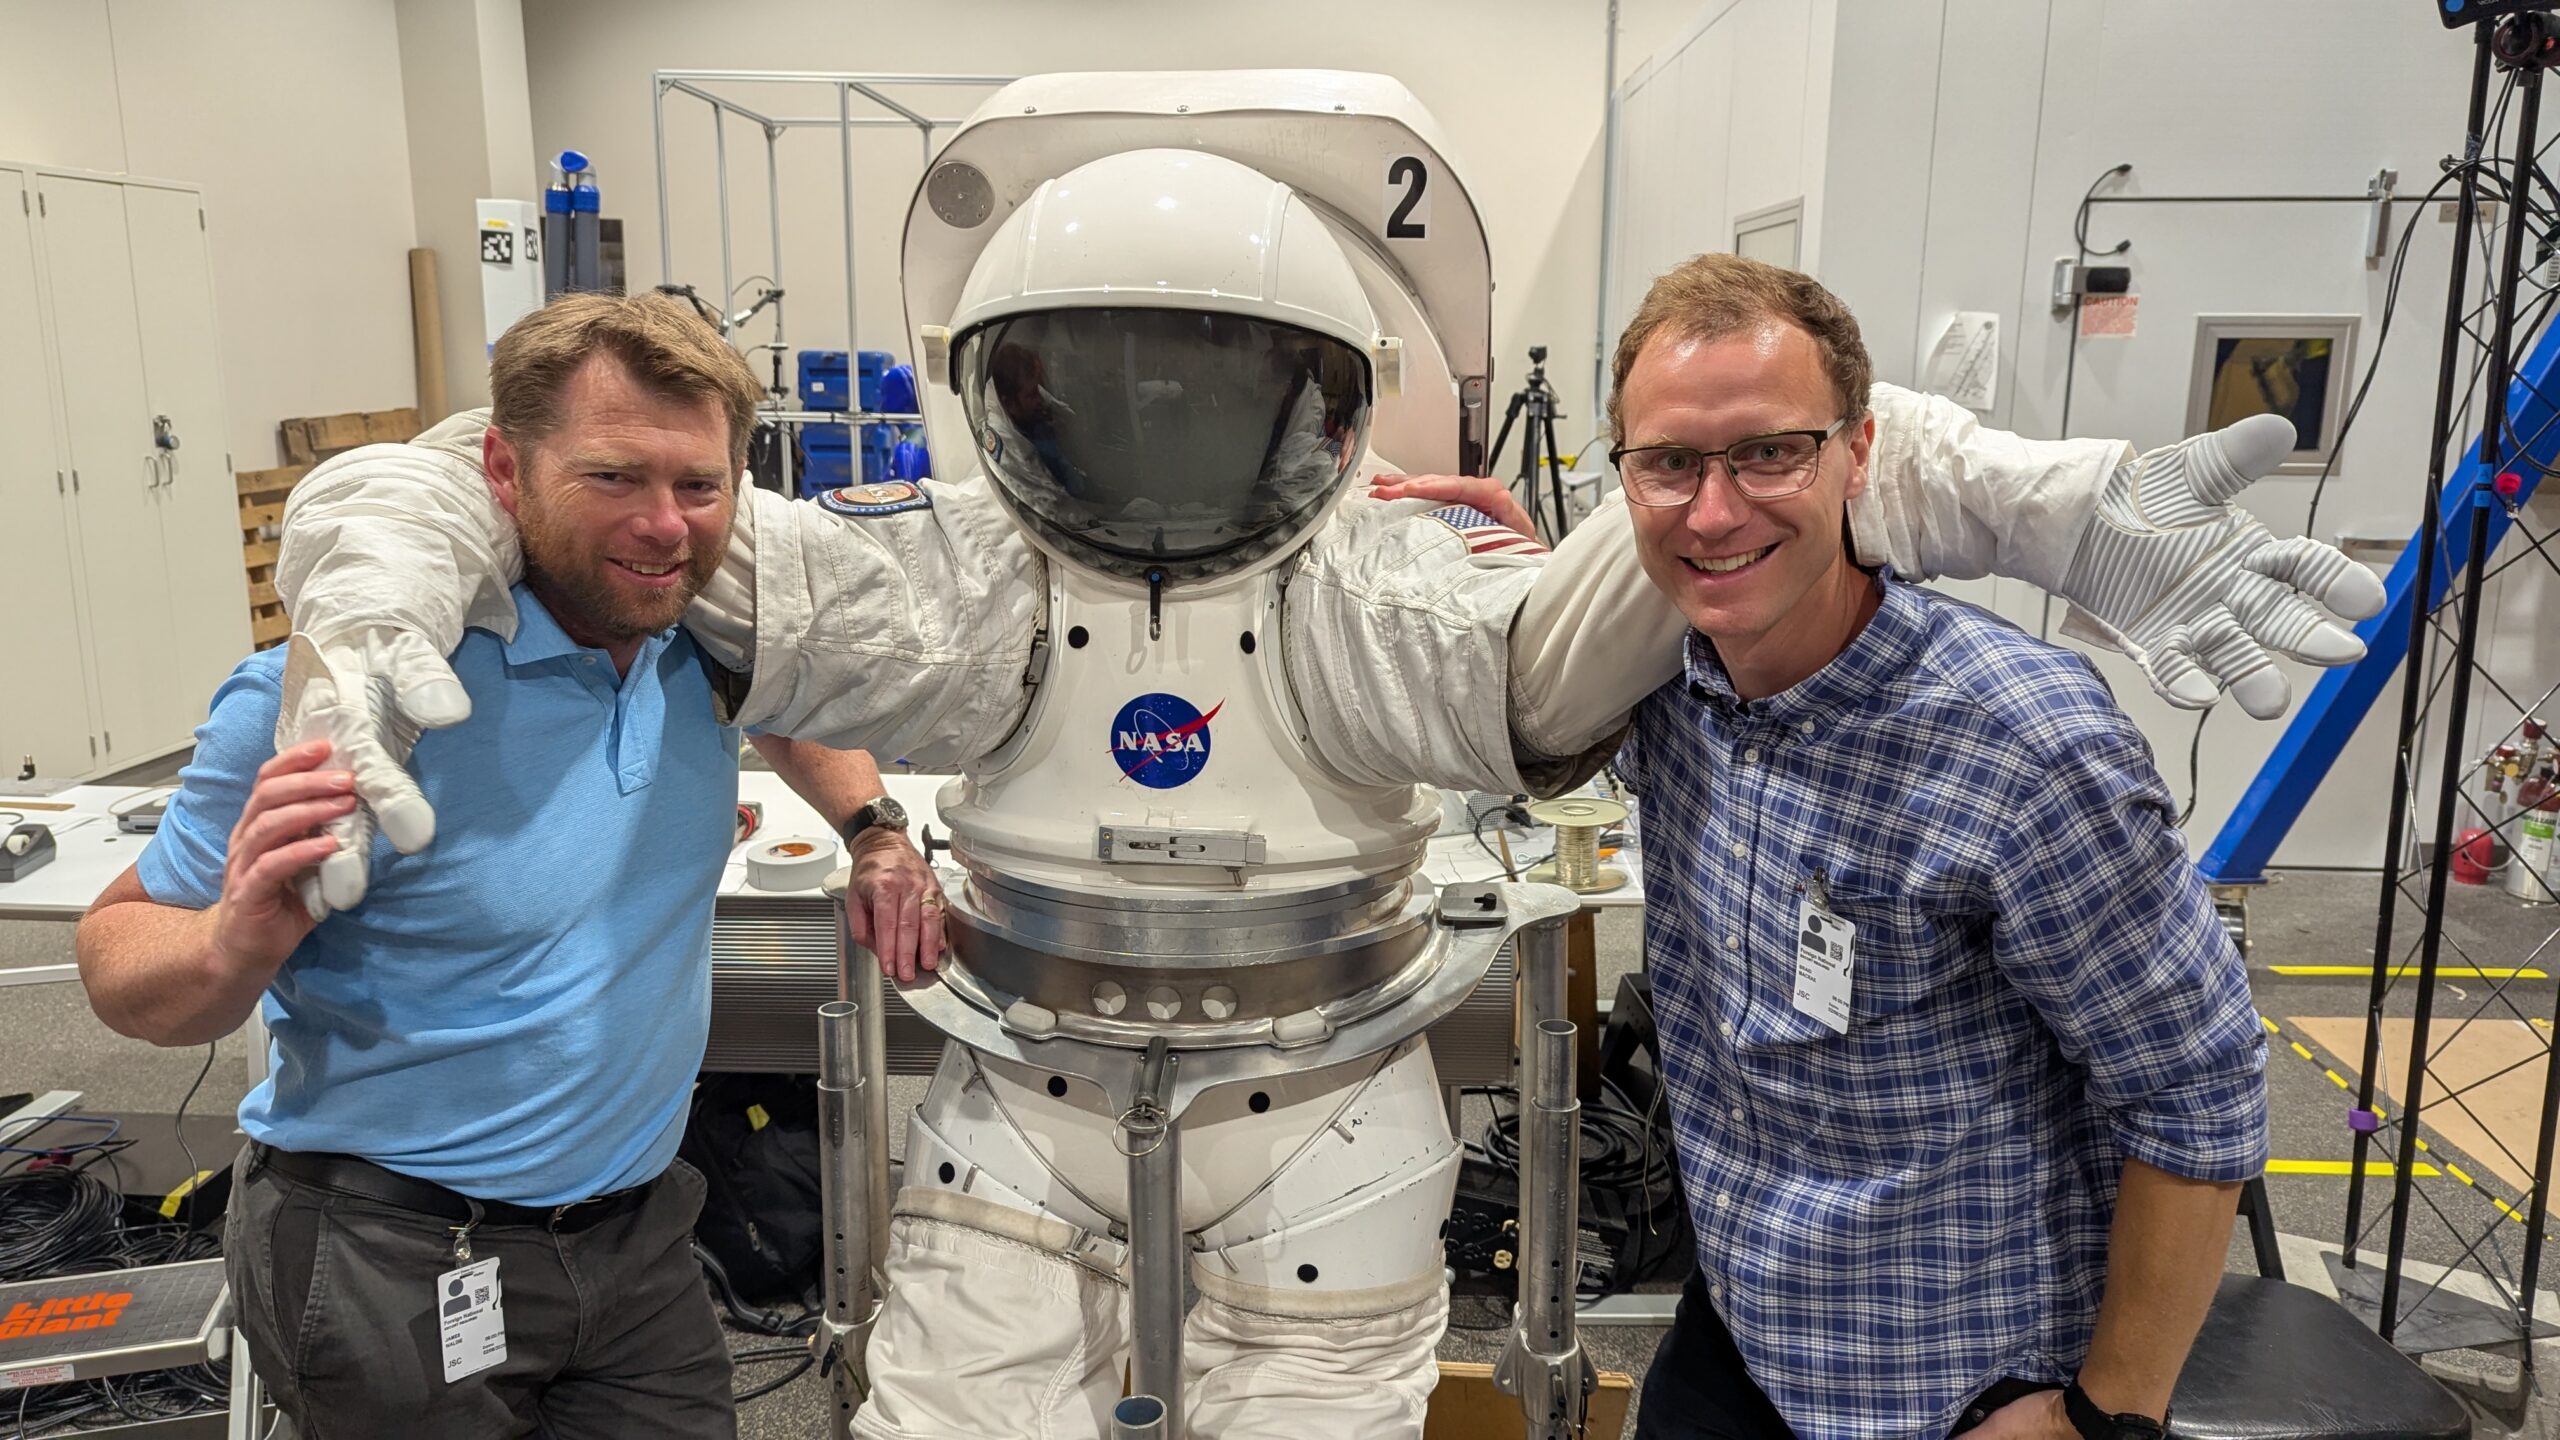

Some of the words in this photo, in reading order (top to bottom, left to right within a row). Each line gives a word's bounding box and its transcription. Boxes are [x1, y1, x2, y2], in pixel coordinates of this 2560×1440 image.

[1387, 156, 1428, 238] 2
[2084, 296, 2139, 306] CAUTION
[1119, 730, 1206, 752] NASA
[1796, 988, 1810, 1001] JSC
[4, 1291, 133, 1322] Little
[0, 1308, 122, 1339] Giant
[448, 1357, 462, 1369] JSC
